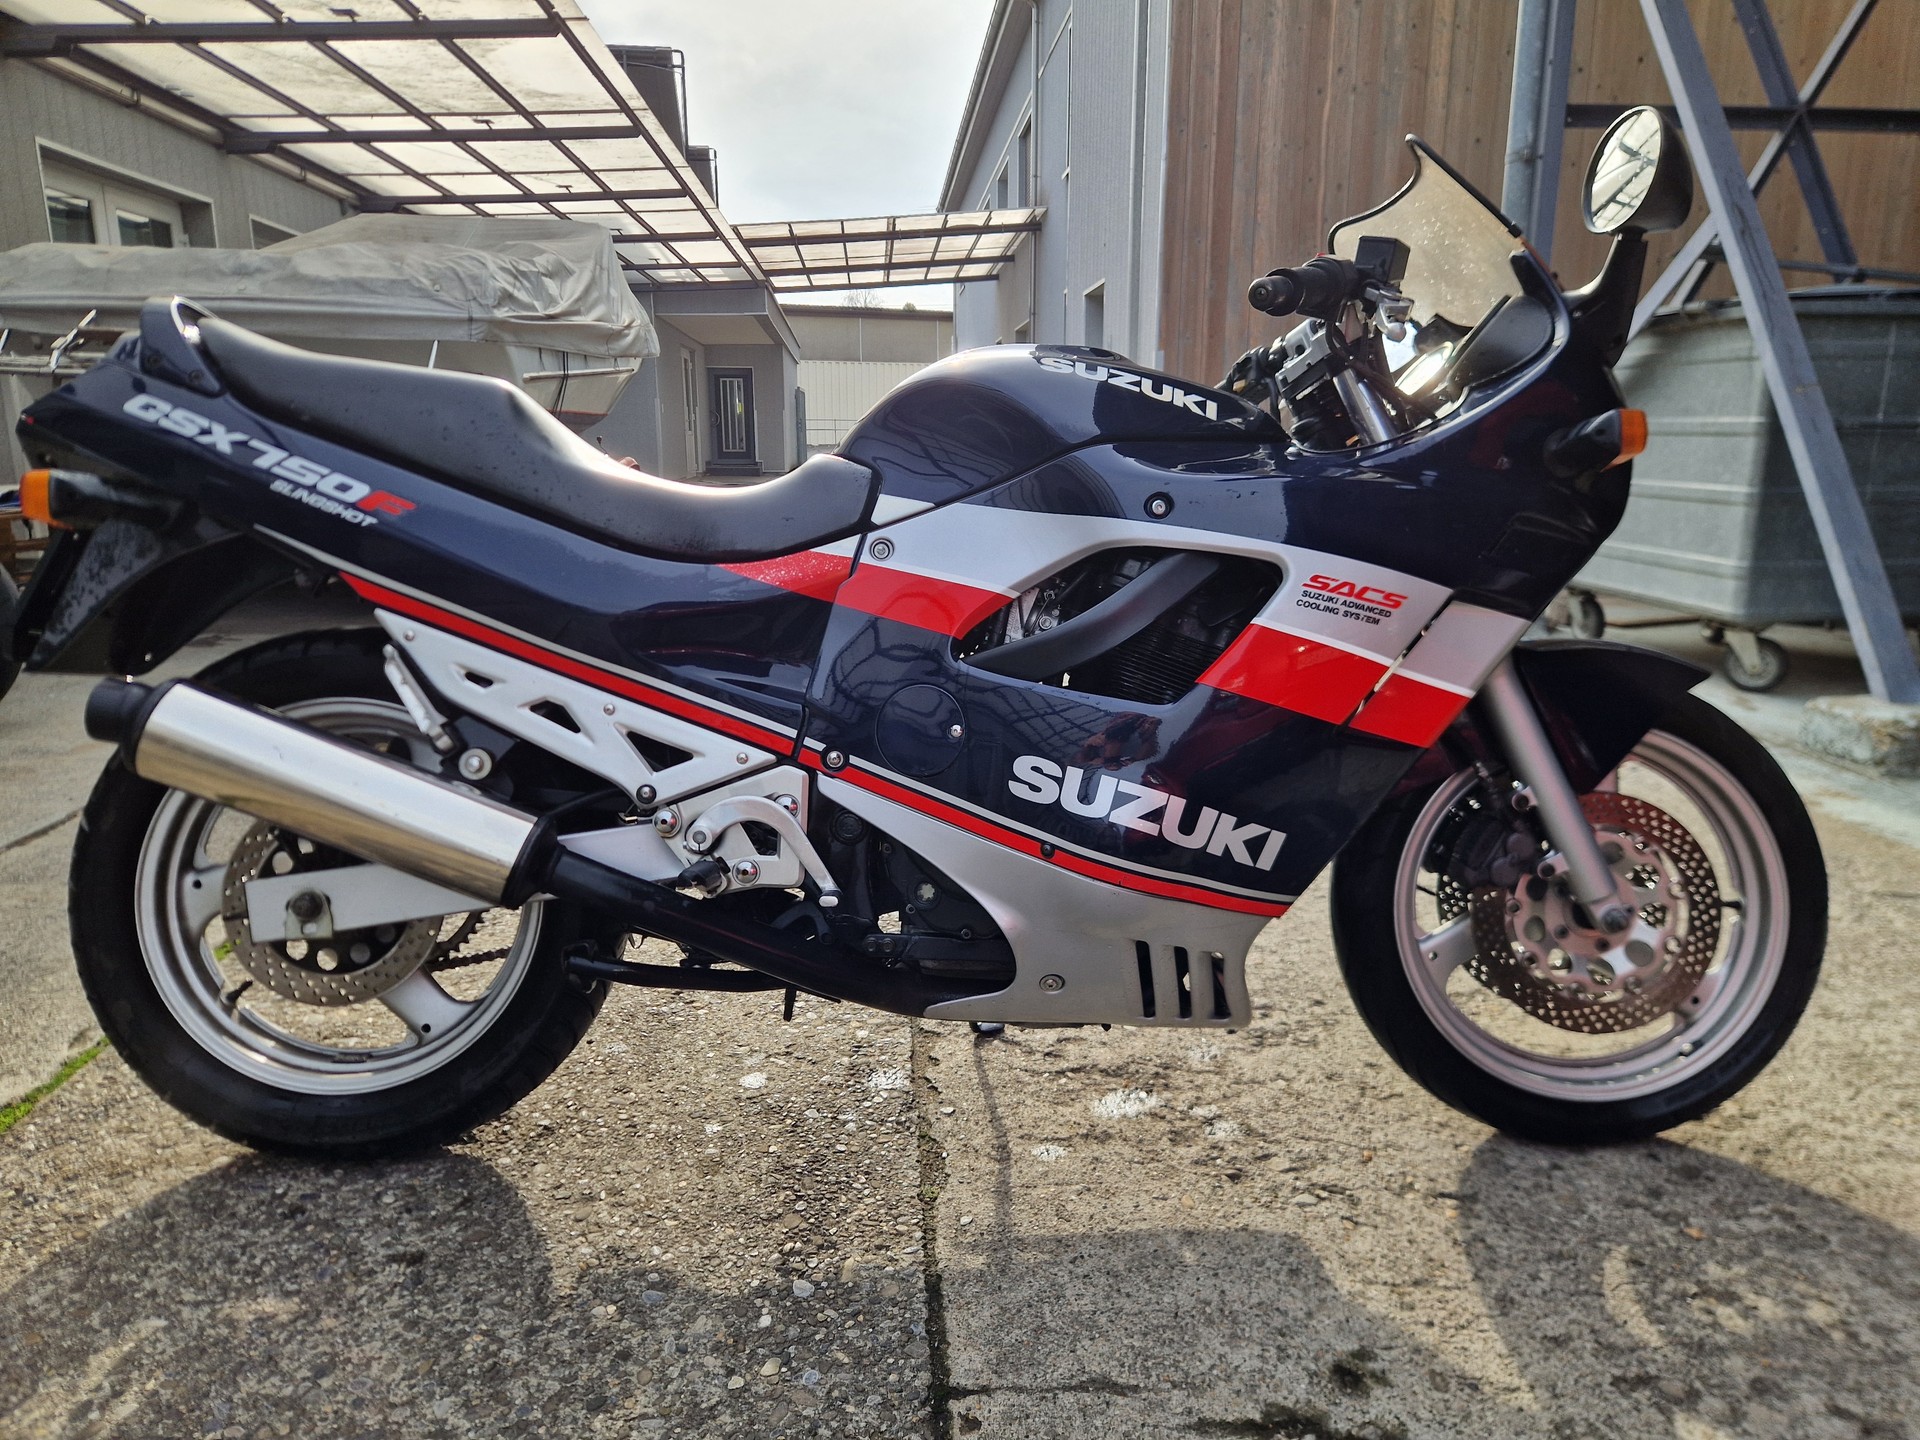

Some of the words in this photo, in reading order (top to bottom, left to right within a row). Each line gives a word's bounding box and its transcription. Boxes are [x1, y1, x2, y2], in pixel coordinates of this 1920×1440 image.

[1039, 357, 1218, 421] SUZUKI
[269, 479, 378, 527] SLINGSHOT
[1296, 599, 1340, 615] COOLING
[1302, 574, 1408, 609] SACS
[1302, 590, 1339, 604] SUZUKI
[1340, 599, 1392, 618] ADVANCED
[1008, 755, 1287, 871] SUZUKI
